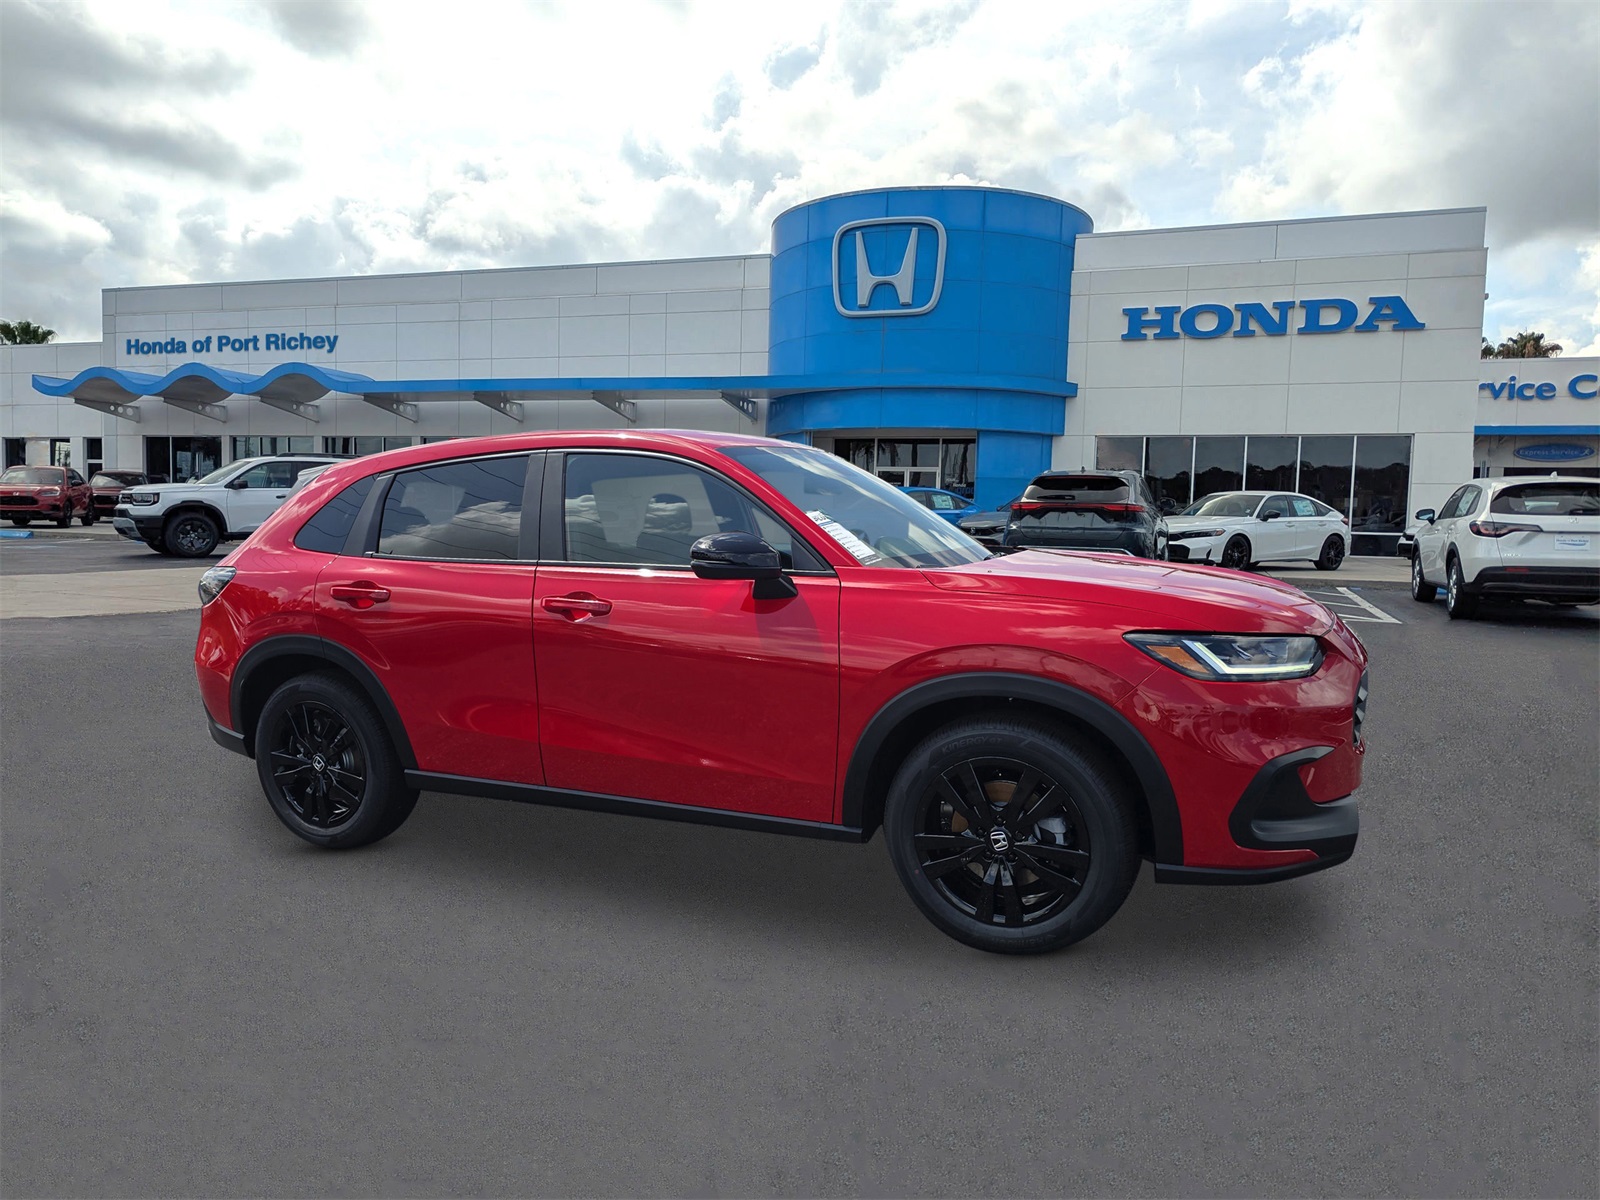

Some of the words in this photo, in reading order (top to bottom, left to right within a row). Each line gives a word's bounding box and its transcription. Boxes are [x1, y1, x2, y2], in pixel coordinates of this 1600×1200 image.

[1121, 295, 1426, 341] HONDA
[126, 337, 188, 355] Honda
[192, 335, 213, 353] of
[217, 334, 260, 353] Port
[265, 332, 339, 354] Richey
[1567, 373, 1600, 400] C
[1519, 449, 1549, 457] Express
[1551, 448, 1580, 456] Service
[942, 736, 989, 754] KINERGY
